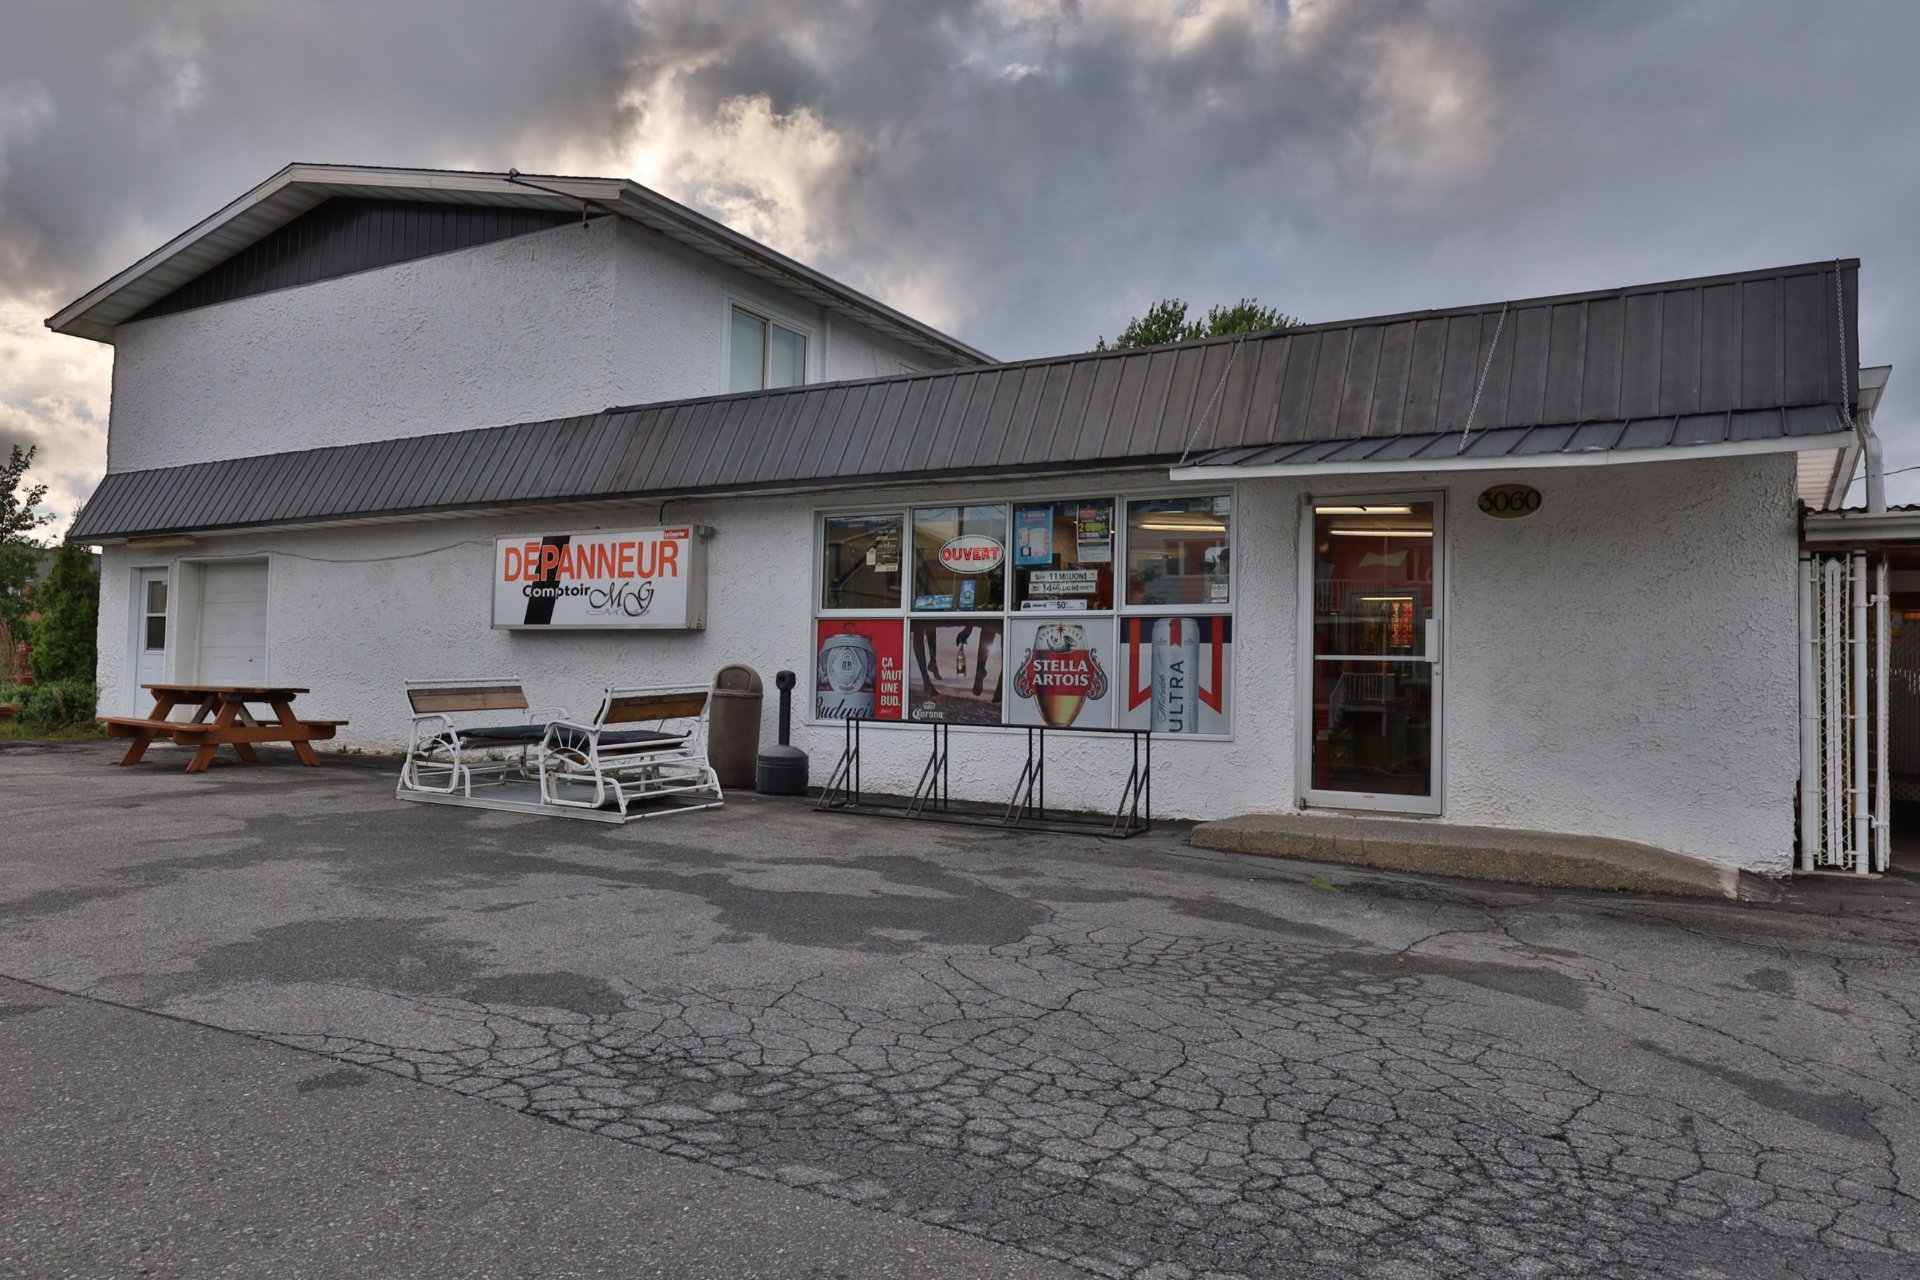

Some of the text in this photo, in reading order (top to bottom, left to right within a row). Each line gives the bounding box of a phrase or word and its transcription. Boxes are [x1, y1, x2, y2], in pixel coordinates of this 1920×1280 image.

[1478, 490, 1542, 512] 3060
[504, 539, 679, 582] DÉPANNEUR
[942, 547, 1000, 561] OUVERT
[522, 583, 590, 599] Comptoir
[881, 657, 893, 670] ÇA
[1033, 659, 1088, 672] STELLA
[881, 670, 903, 680] VAUT
[1032, 673, 1089, 686] ARTOIS
[881, 683, 899, 693] UNE
[880, 696, 901, 706] BUD.
[1168, 660, 1184, 732] ULTRA
[912, 708, 944, 720] Corona
